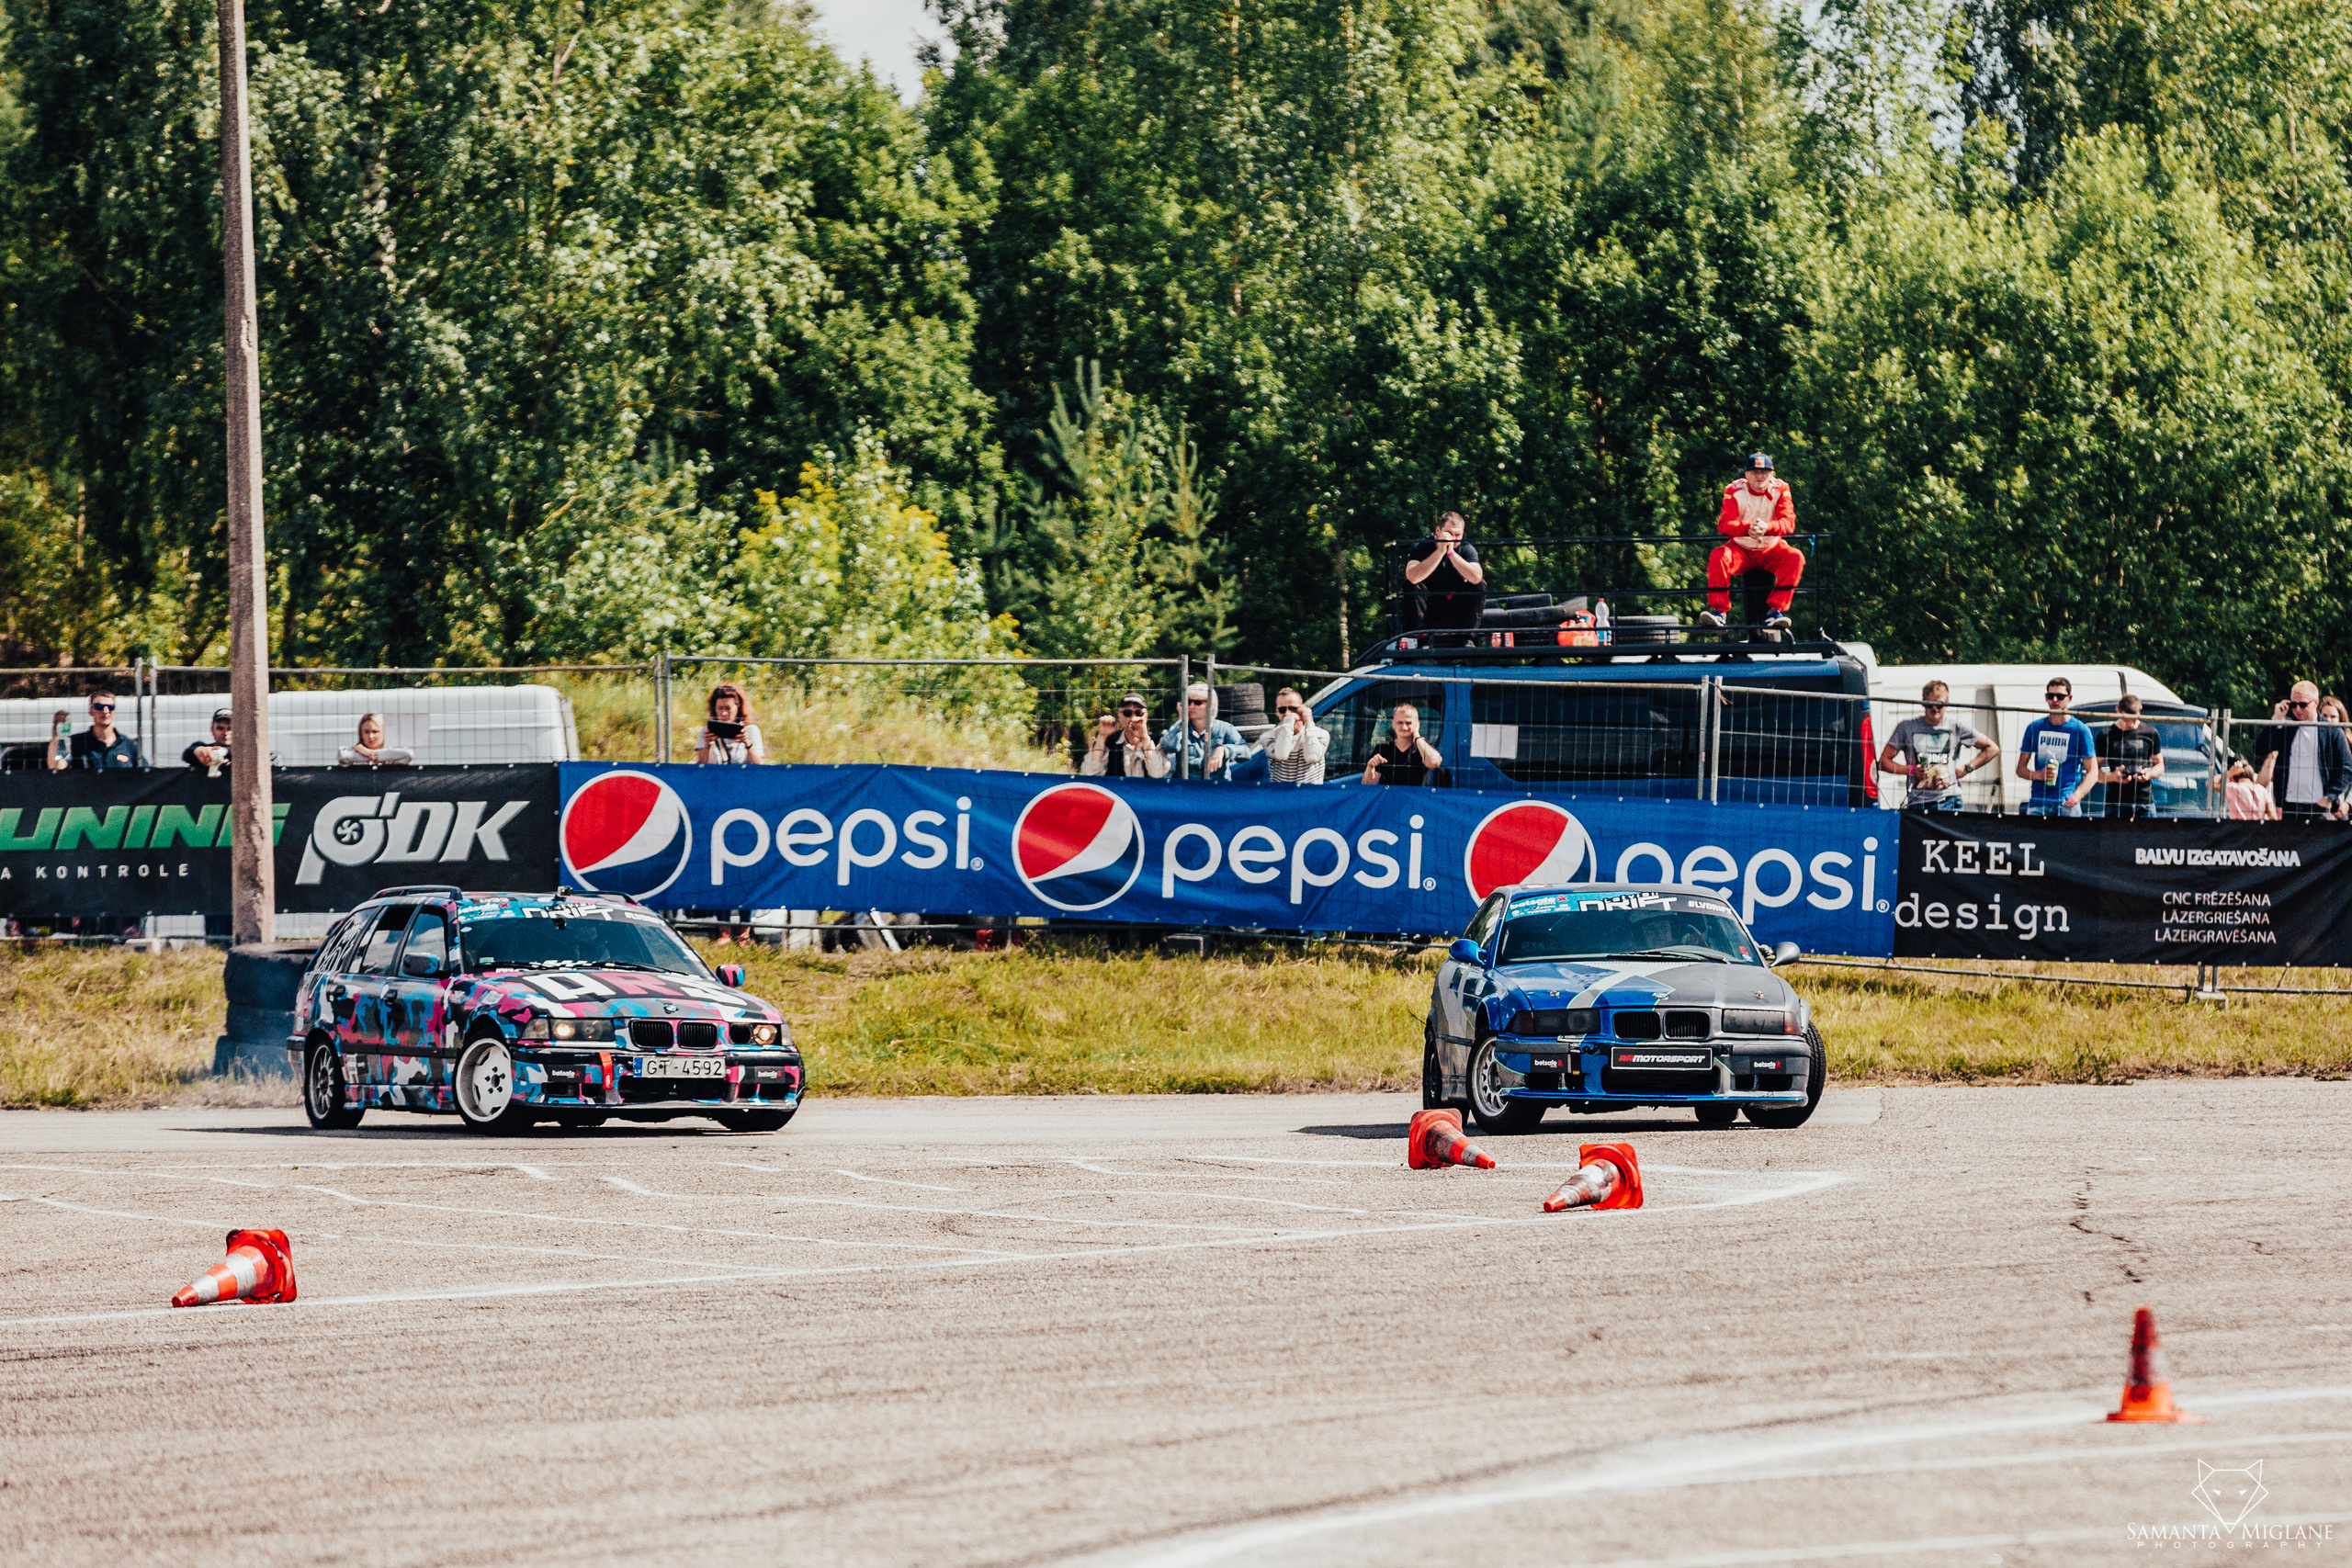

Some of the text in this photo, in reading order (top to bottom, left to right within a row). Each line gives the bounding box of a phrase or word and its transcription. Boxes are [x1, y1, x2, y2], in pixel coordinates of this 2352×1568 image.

[2041, 736, 2066, 747] PUMA
[711, 796, 969, 886] pepsi
[35, 863, 189, 879] KONTROLE
[1161, 815, 1424, 905] pepsi
[1921, 838, 2045, 877] KEEL
[2135, 847, 2301, 867] BALVU IZGATAVOŠANA
[2162, 891, 2192, 906] CNC
[1894, 892, 2070, 942] design
